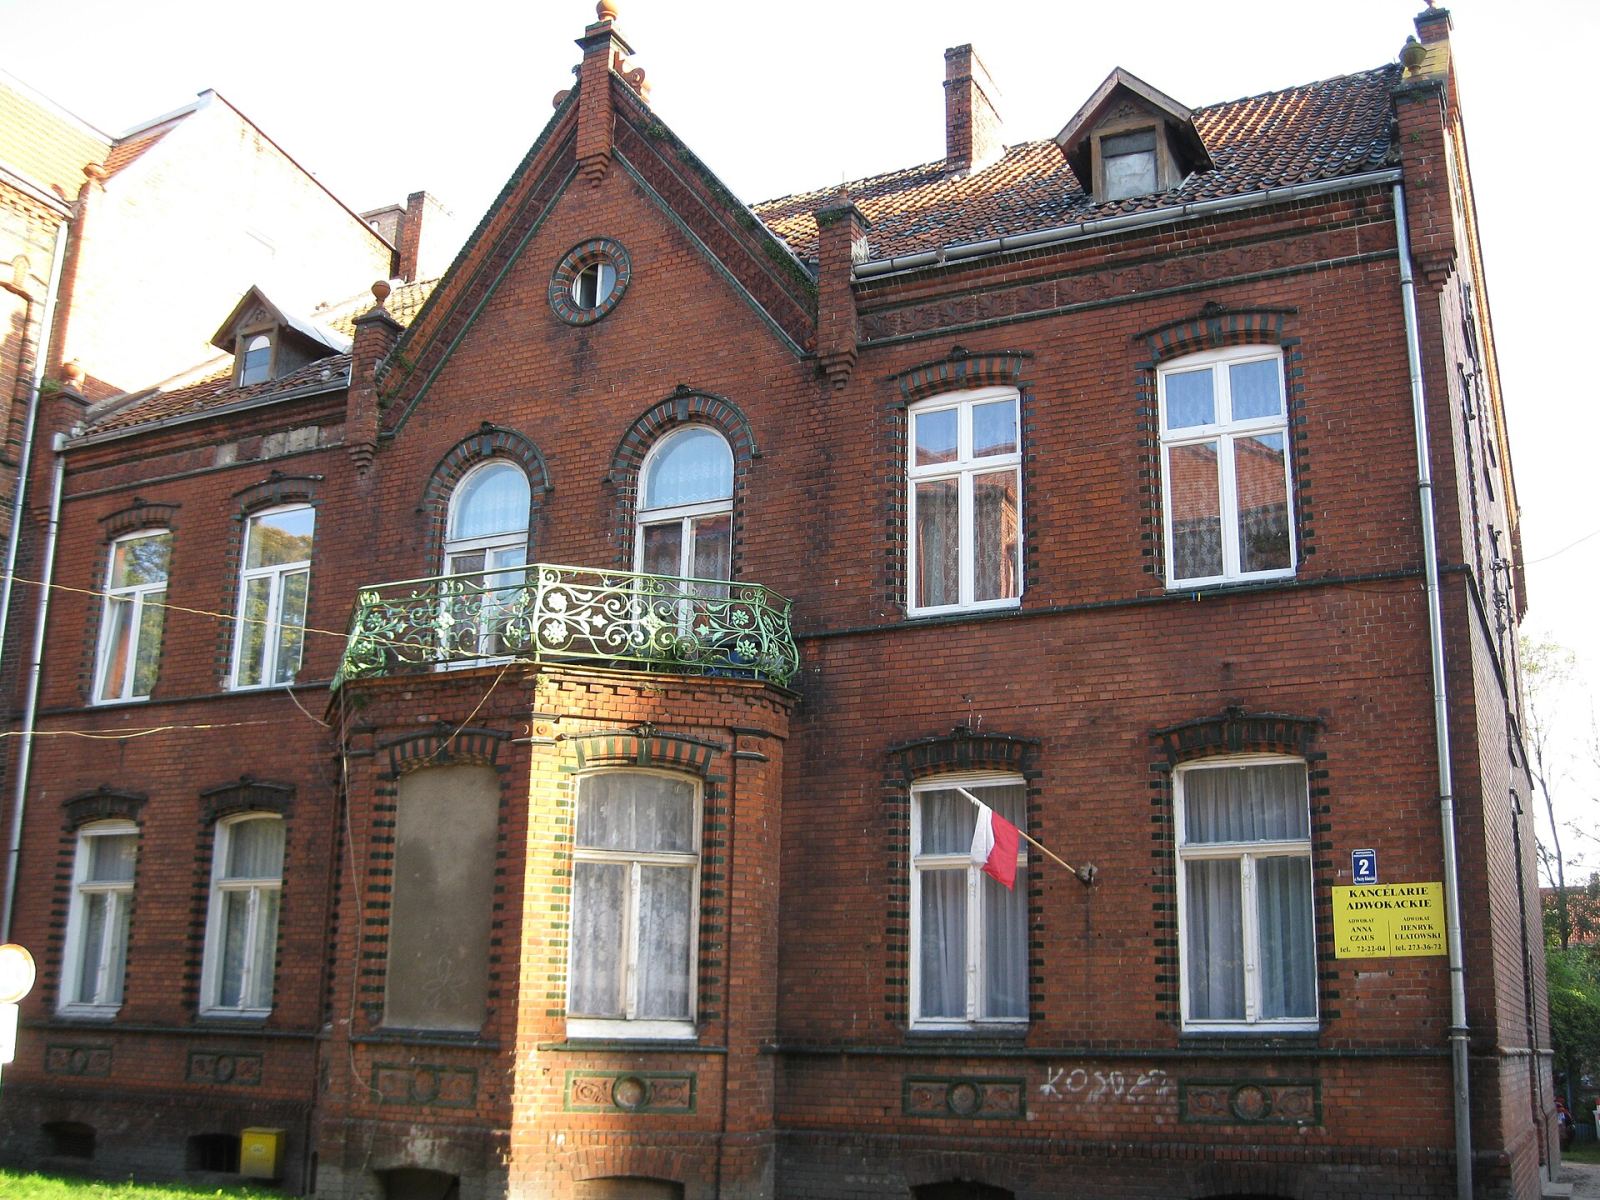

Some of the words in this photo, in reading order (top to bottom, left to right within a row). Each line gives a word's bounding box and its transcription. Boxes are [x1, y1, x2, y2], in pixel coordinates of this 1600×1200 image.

[1359, 859, 1369, 875] 2
[1349, 887, 1429, 898] KANCELARIE
[1347, 899, 1432, 910] ADWOKACKIE
[1350, 934, 1375, 942] CZAUS
